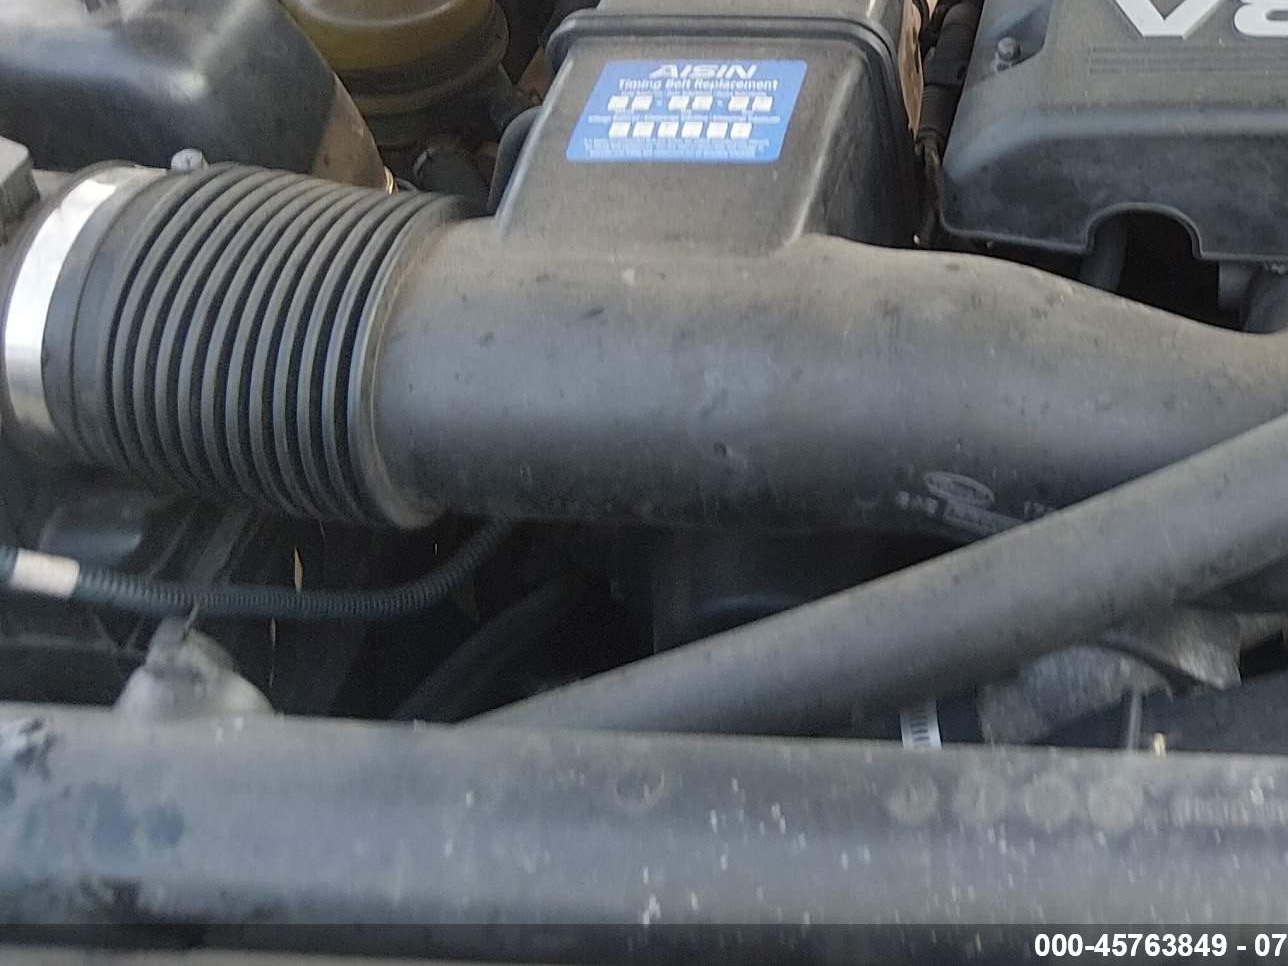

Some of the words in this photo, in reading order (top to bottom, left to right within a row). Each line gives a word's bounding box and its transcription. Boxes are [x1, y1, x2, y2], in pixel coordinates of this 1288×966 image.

[649, 64, 757, 79] AISIN
[619, 78, 661, 91] Timing
[665, 78, 690, 90] Belt
[693, 78, 778, 92] Replacement
